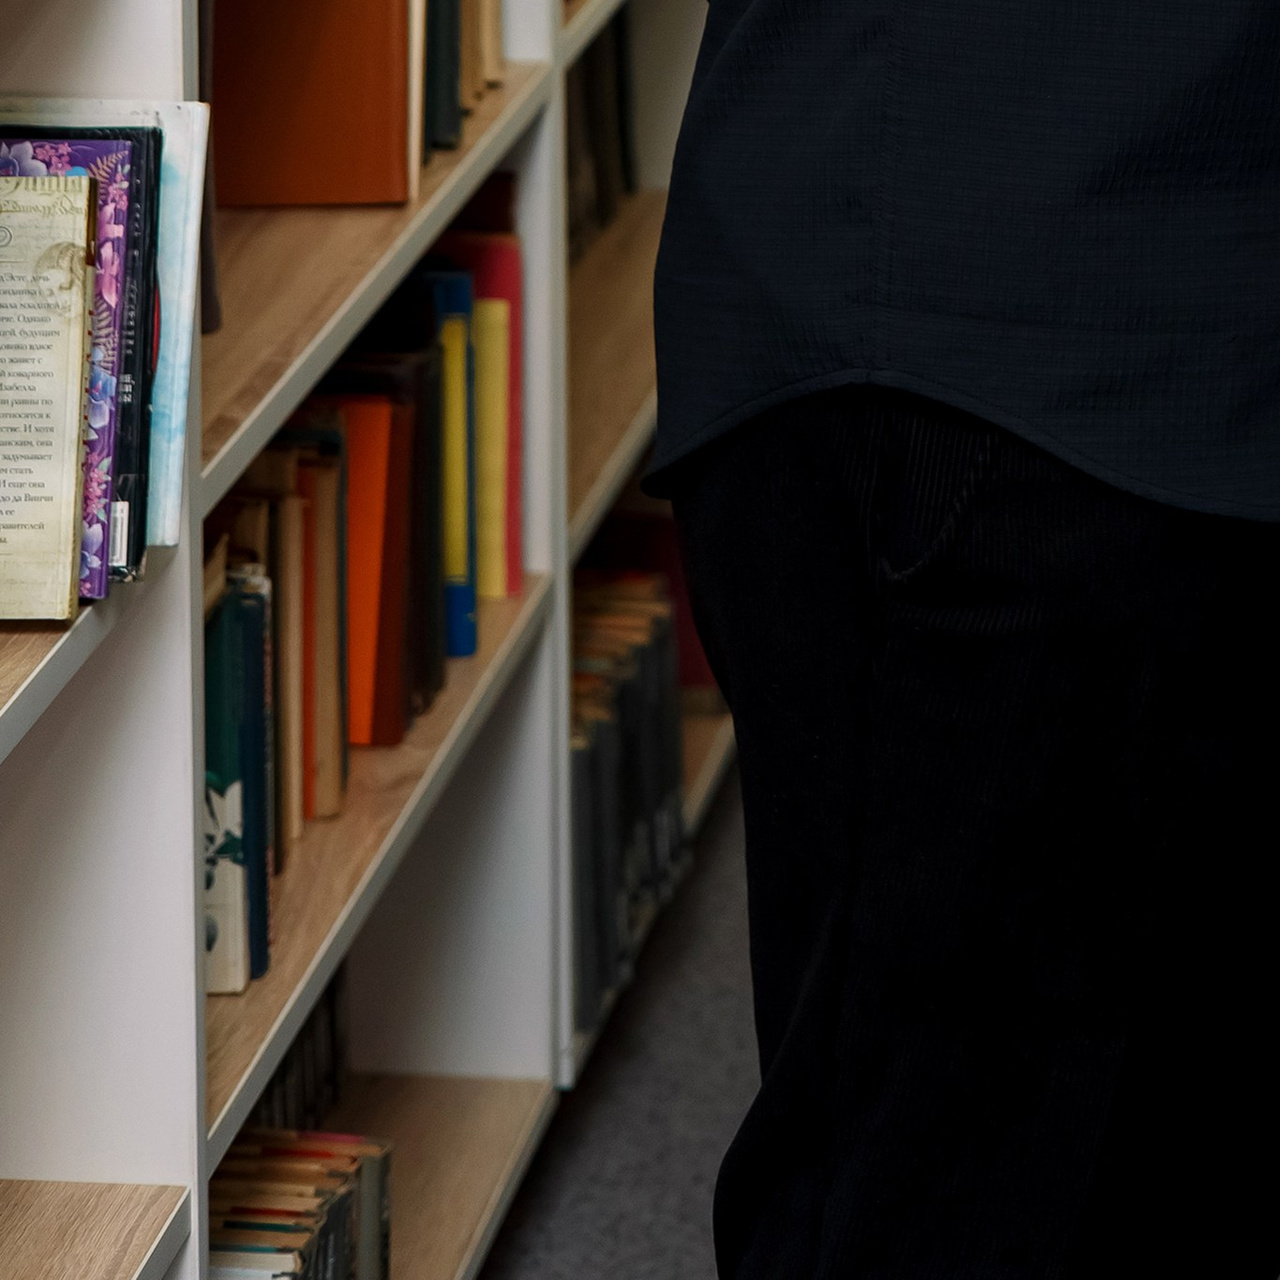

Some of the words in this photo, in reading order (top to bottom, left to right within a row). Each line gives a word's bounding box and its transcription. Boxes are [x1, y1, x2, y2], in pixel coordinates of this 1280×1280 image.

[18, 314, 51, 323] Однако
[19, 329, 60, 338] будущим
[8, 371, 54, 379] коварного
[11, 399, 39, 407] равны
[24, 424, 32, 432] И
[1, 454, 53, 462] задумывает
[24, 493, 53, 502] Винчи
